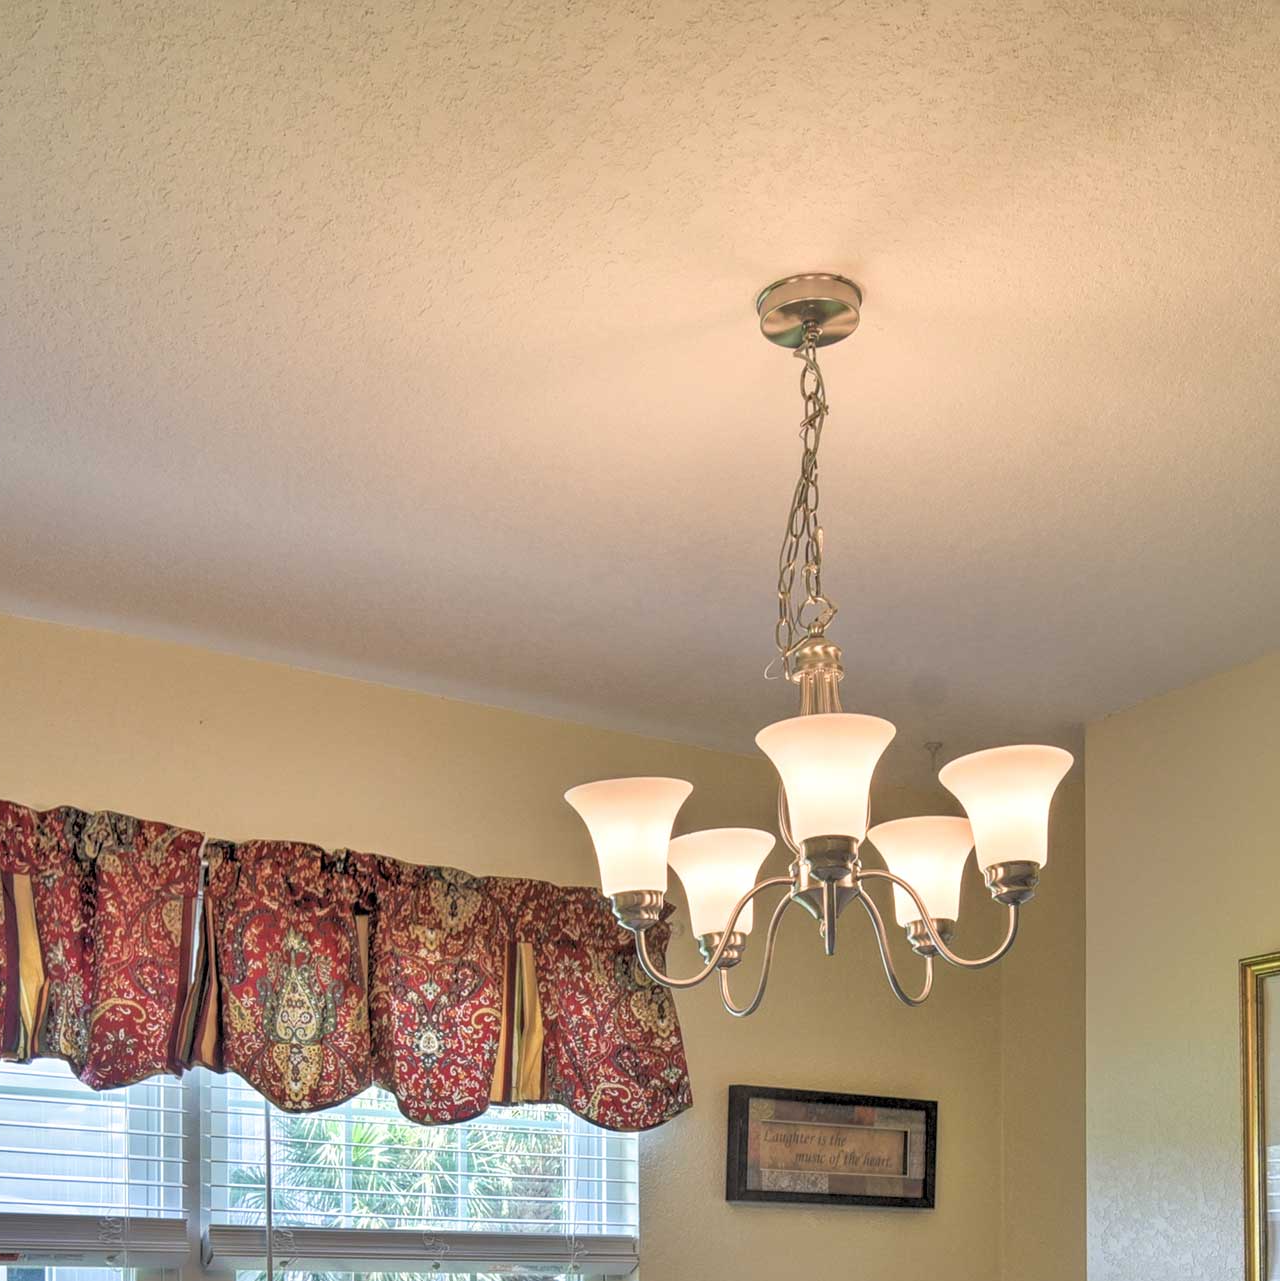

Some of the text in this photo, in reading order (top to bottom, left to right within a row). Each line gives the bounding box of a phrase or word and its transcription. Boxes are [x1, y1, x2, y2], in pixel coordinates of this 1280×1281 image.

[763, 1129, 847, 1148] Laughter is the
[795, 1151, 825, 1165] music
[829, 1150, 843, 1168] of
[843, 1150, 860, 1168] the
